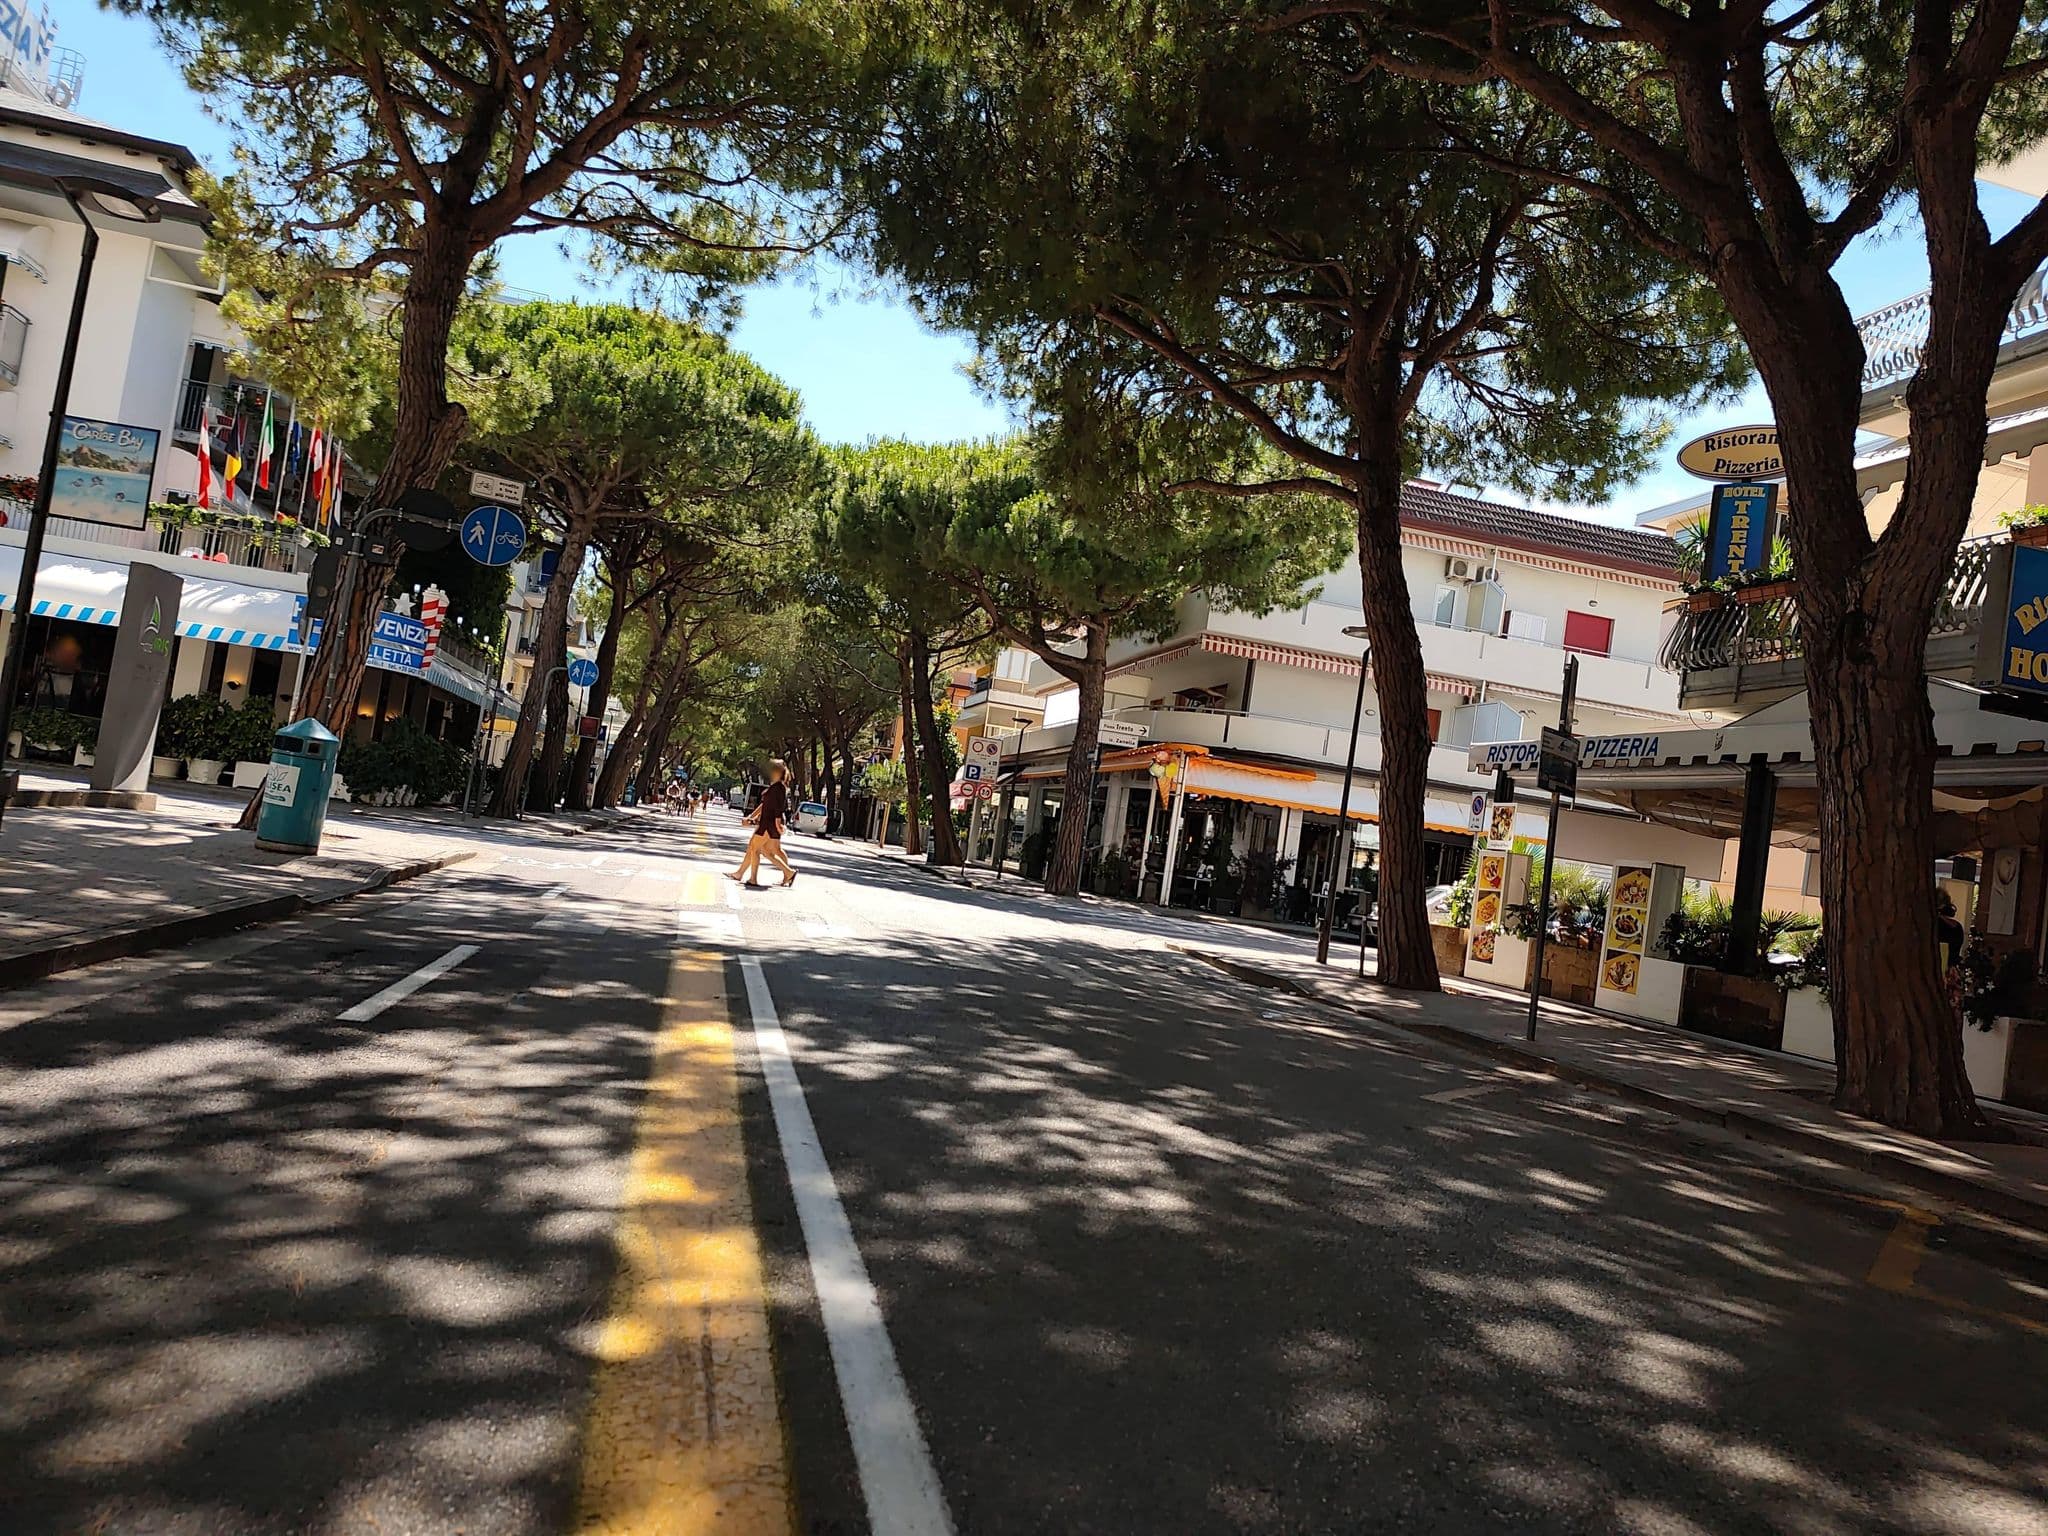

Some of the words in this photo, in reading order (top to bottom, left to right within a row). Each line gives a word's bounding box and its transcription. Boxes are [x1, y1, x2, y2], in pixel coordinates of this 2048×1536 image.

[0, 0, 30, 60] ZA
[118, 429, 144, 451] BAY
[1713, 457, 1780, 474] Pizzeria
[1723, 486, 1766, 498] HOTEL
[368, 646, 412, 666] LETTA
[1583, 737, 1658, 758] PIZZERIA
